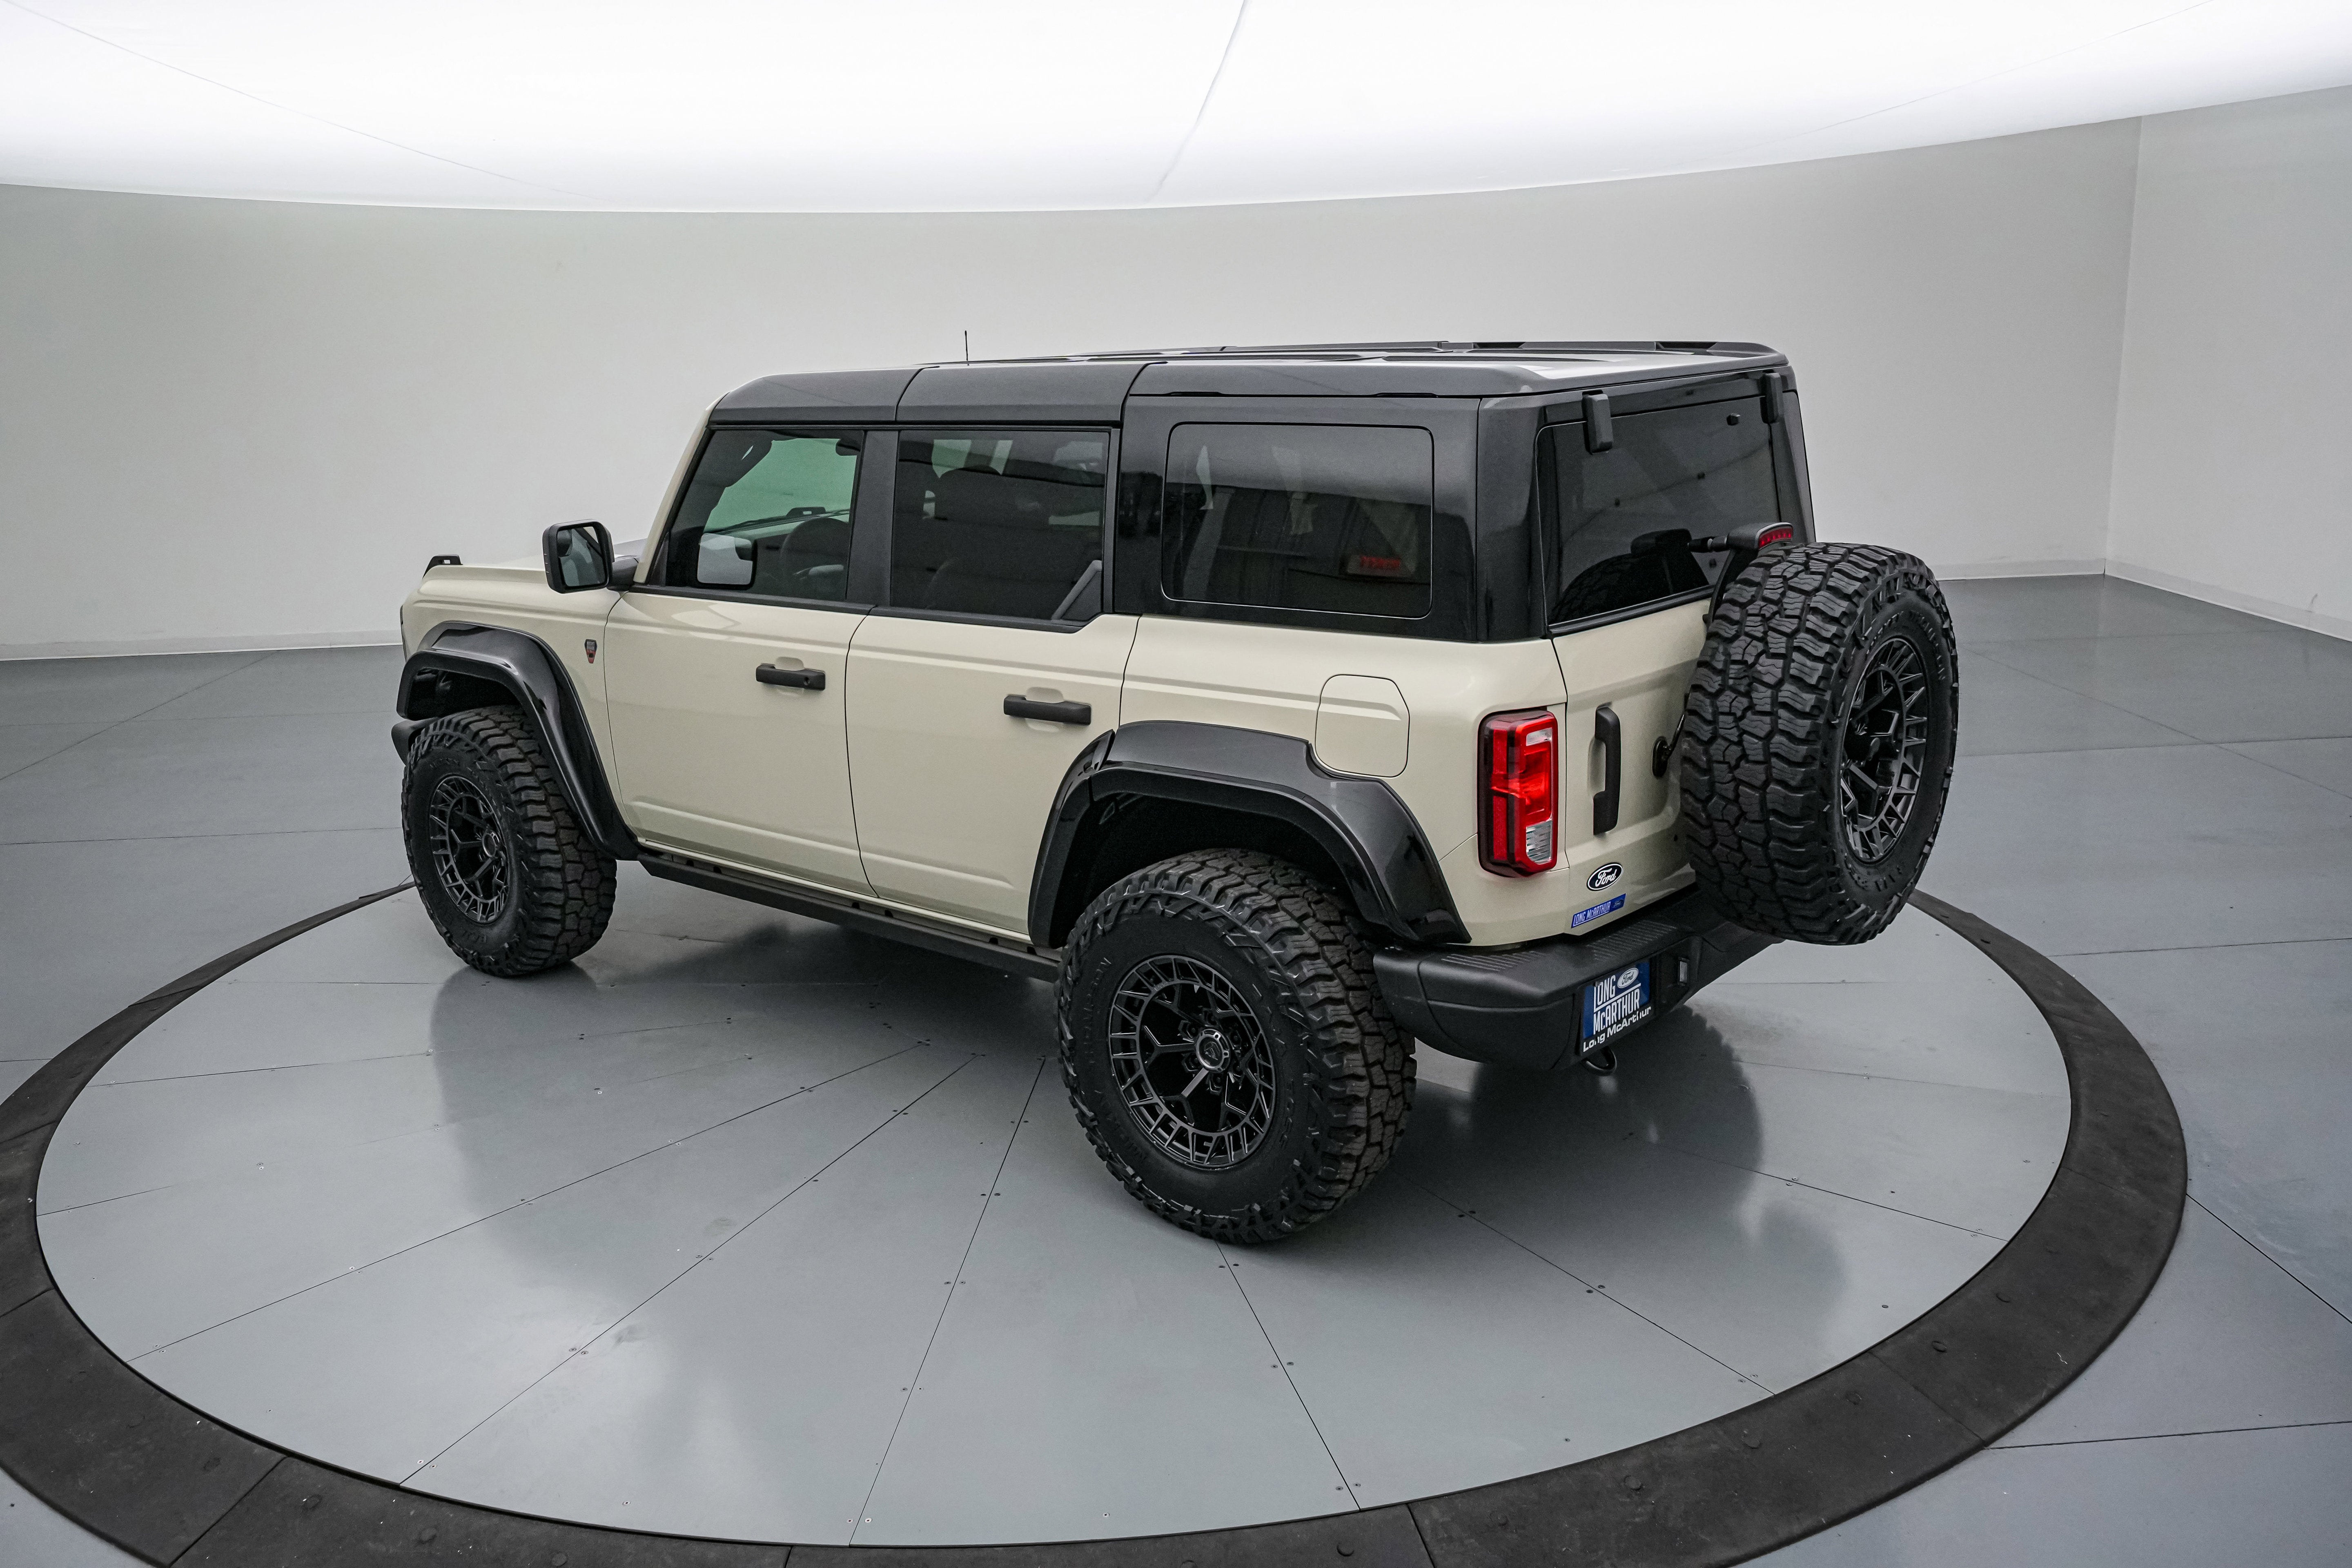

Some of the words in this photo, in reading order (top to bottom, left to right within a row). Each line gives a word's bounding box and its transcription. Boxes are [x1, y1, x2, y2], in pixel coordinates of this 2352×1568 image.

[1595, 868, 1617, 887] Ford
[1573, 911, 1586, 927] LONG
[1586, 901, 1611, 920] McARTHUR
[1622, 971, 1634, 985] Ford
[1594, 975, 1616, 1013] LONG
[1593, 988, 1640, 1035] McARTHUR
